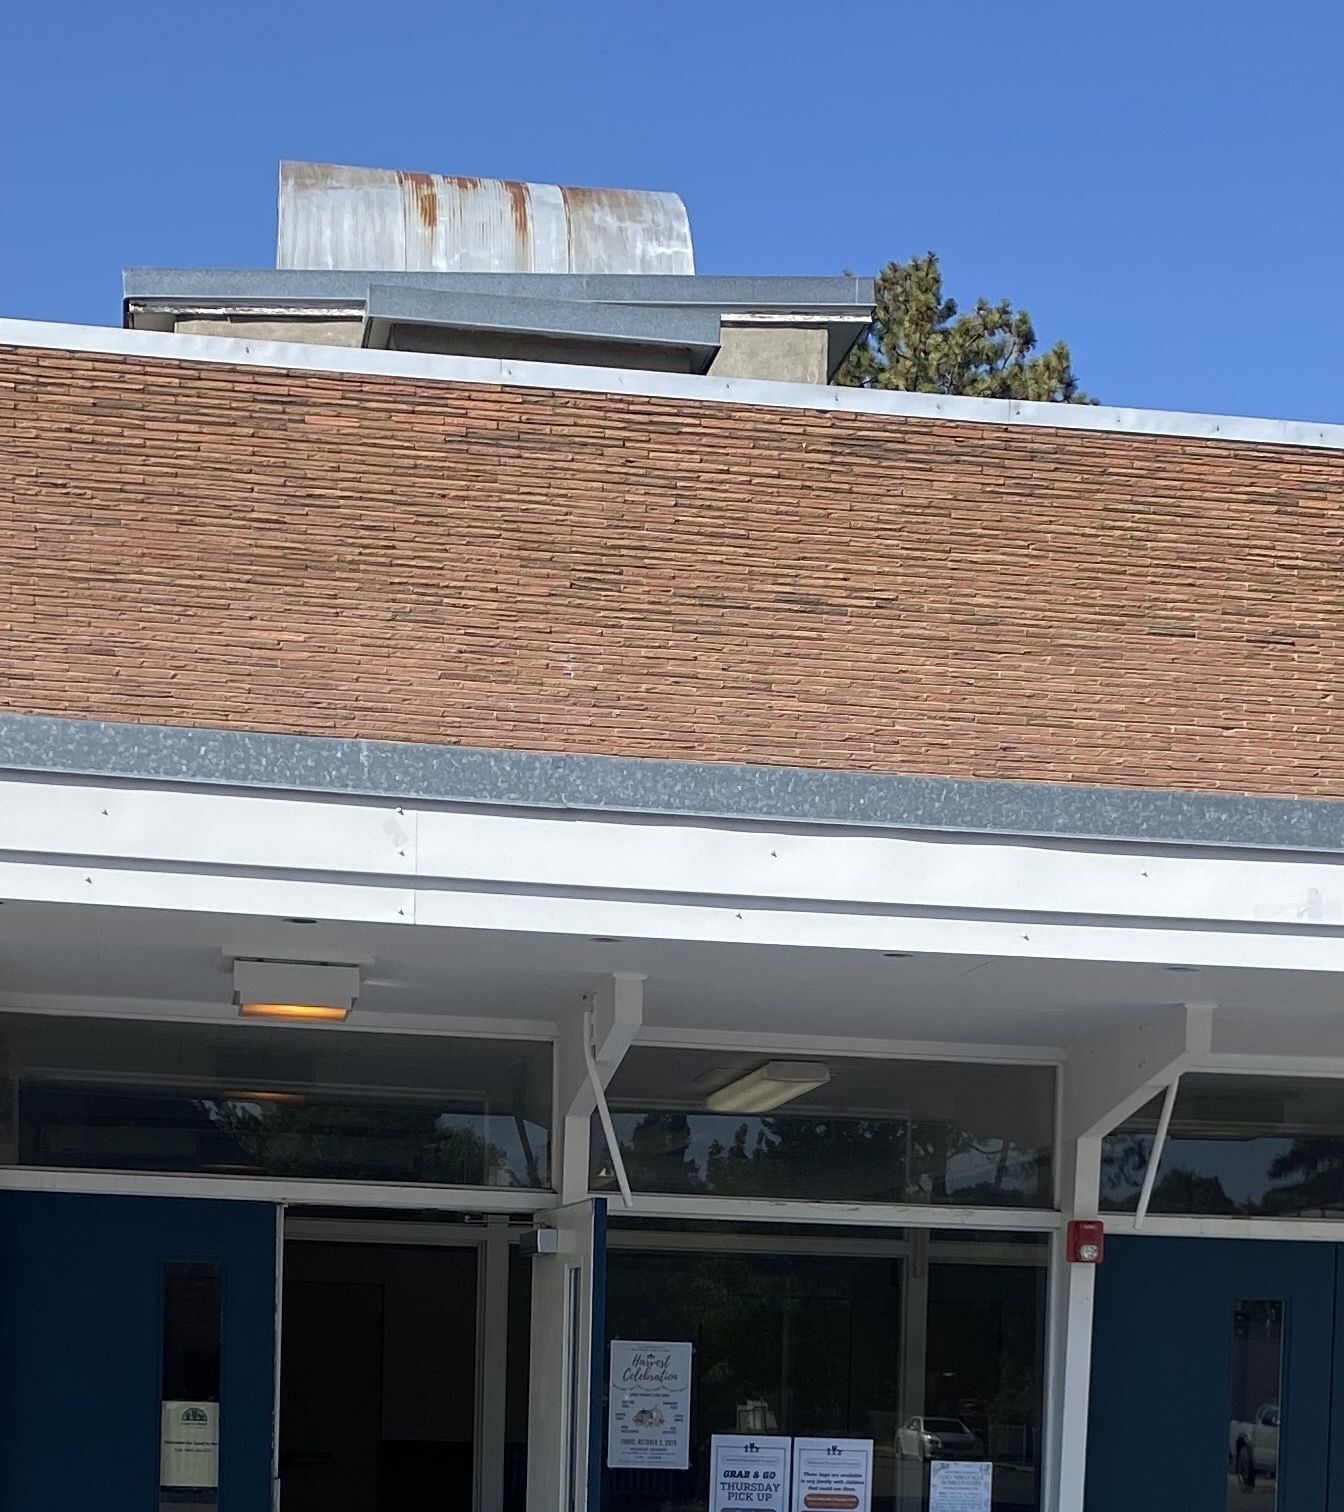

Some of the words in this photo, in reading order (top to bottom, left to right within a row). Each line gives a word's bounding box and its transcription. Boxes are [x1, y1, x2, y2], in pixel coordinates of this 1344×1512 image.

[622, 1367, 678, 1383] Celebration
[723, 1470, 751, 1479] GRAB
[763, 1471, 776, 1479] GO
[720, 1482, 780, 1493] THURSDAY
[727, 1492, 754, 1502] PICK
[757, 1493, 773, 1502] UP
